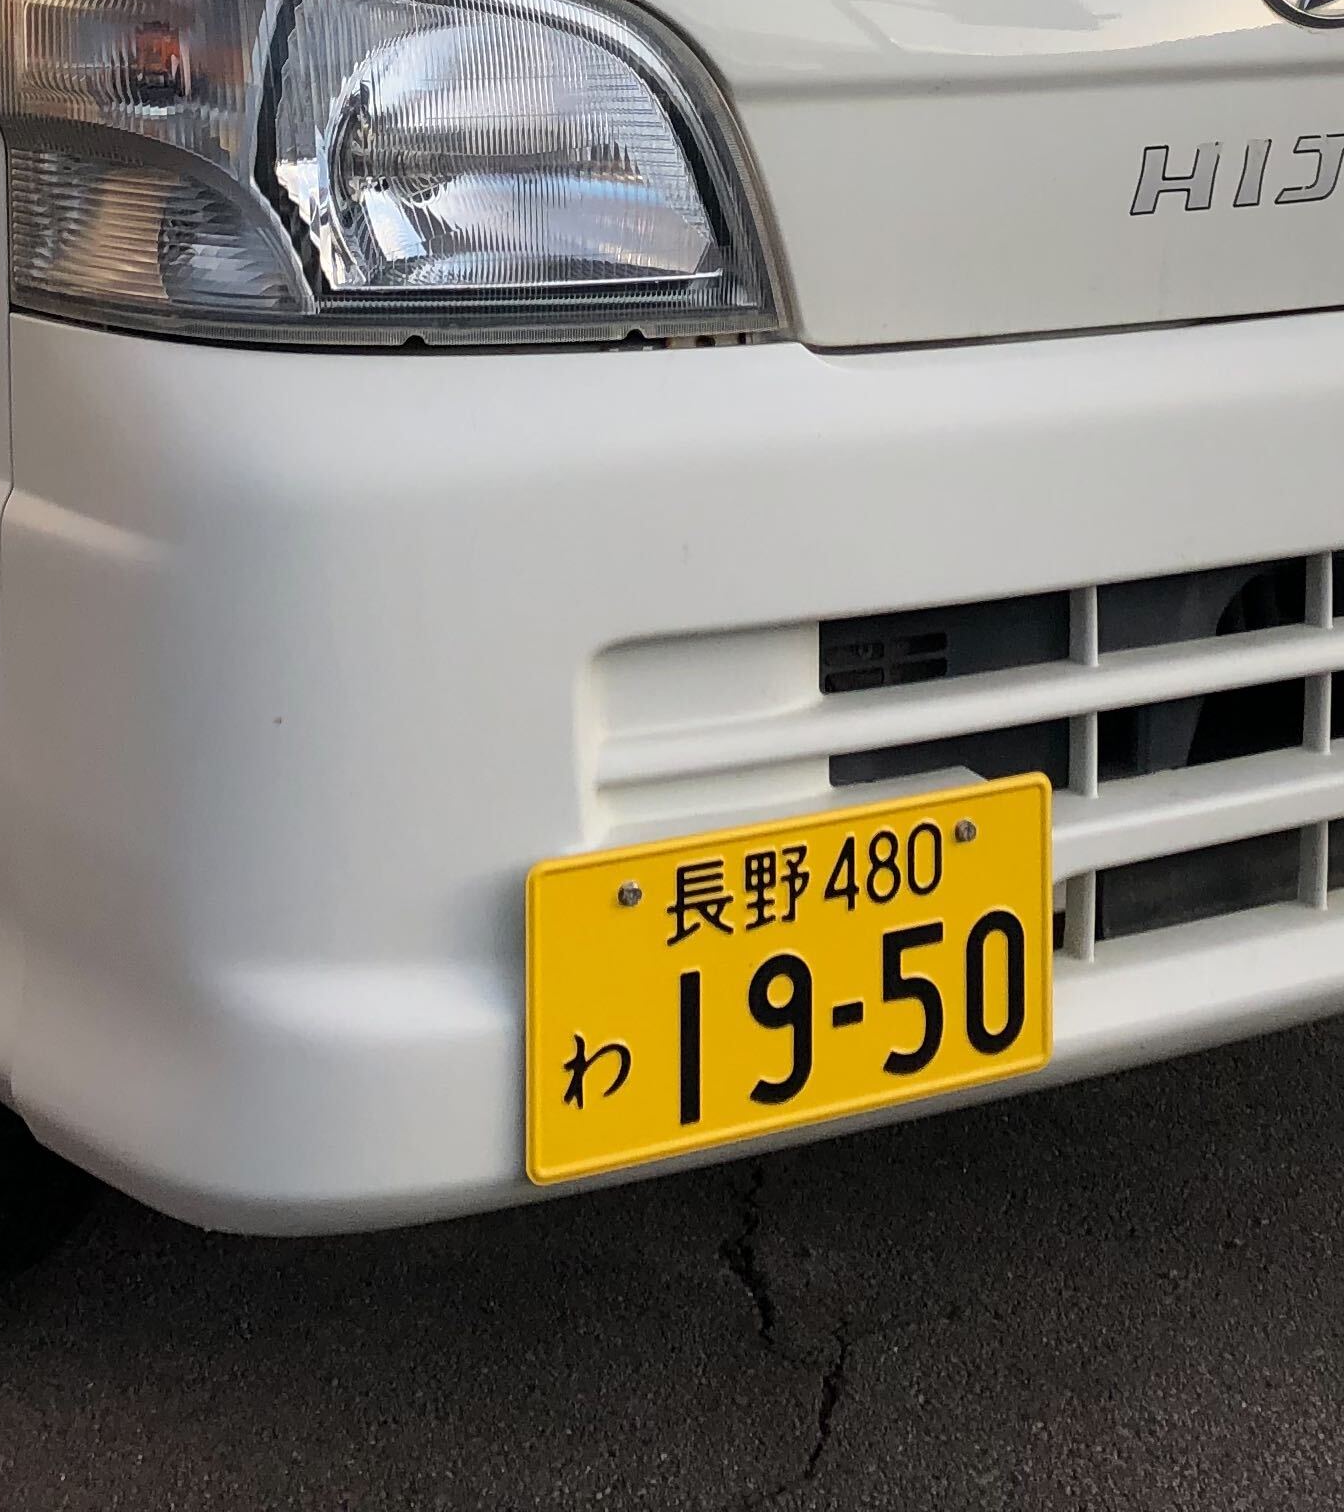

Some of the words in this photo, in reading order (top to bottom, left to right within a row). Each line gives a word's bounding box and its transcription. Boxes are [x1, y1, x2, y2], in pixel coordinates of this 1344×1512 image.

[666, 844, 810, 946] 長野
[823, 822, 943, 912] 480
[562, 1034, 632, 1110] わ
[678, 909, 1026, 1126] 19-50
